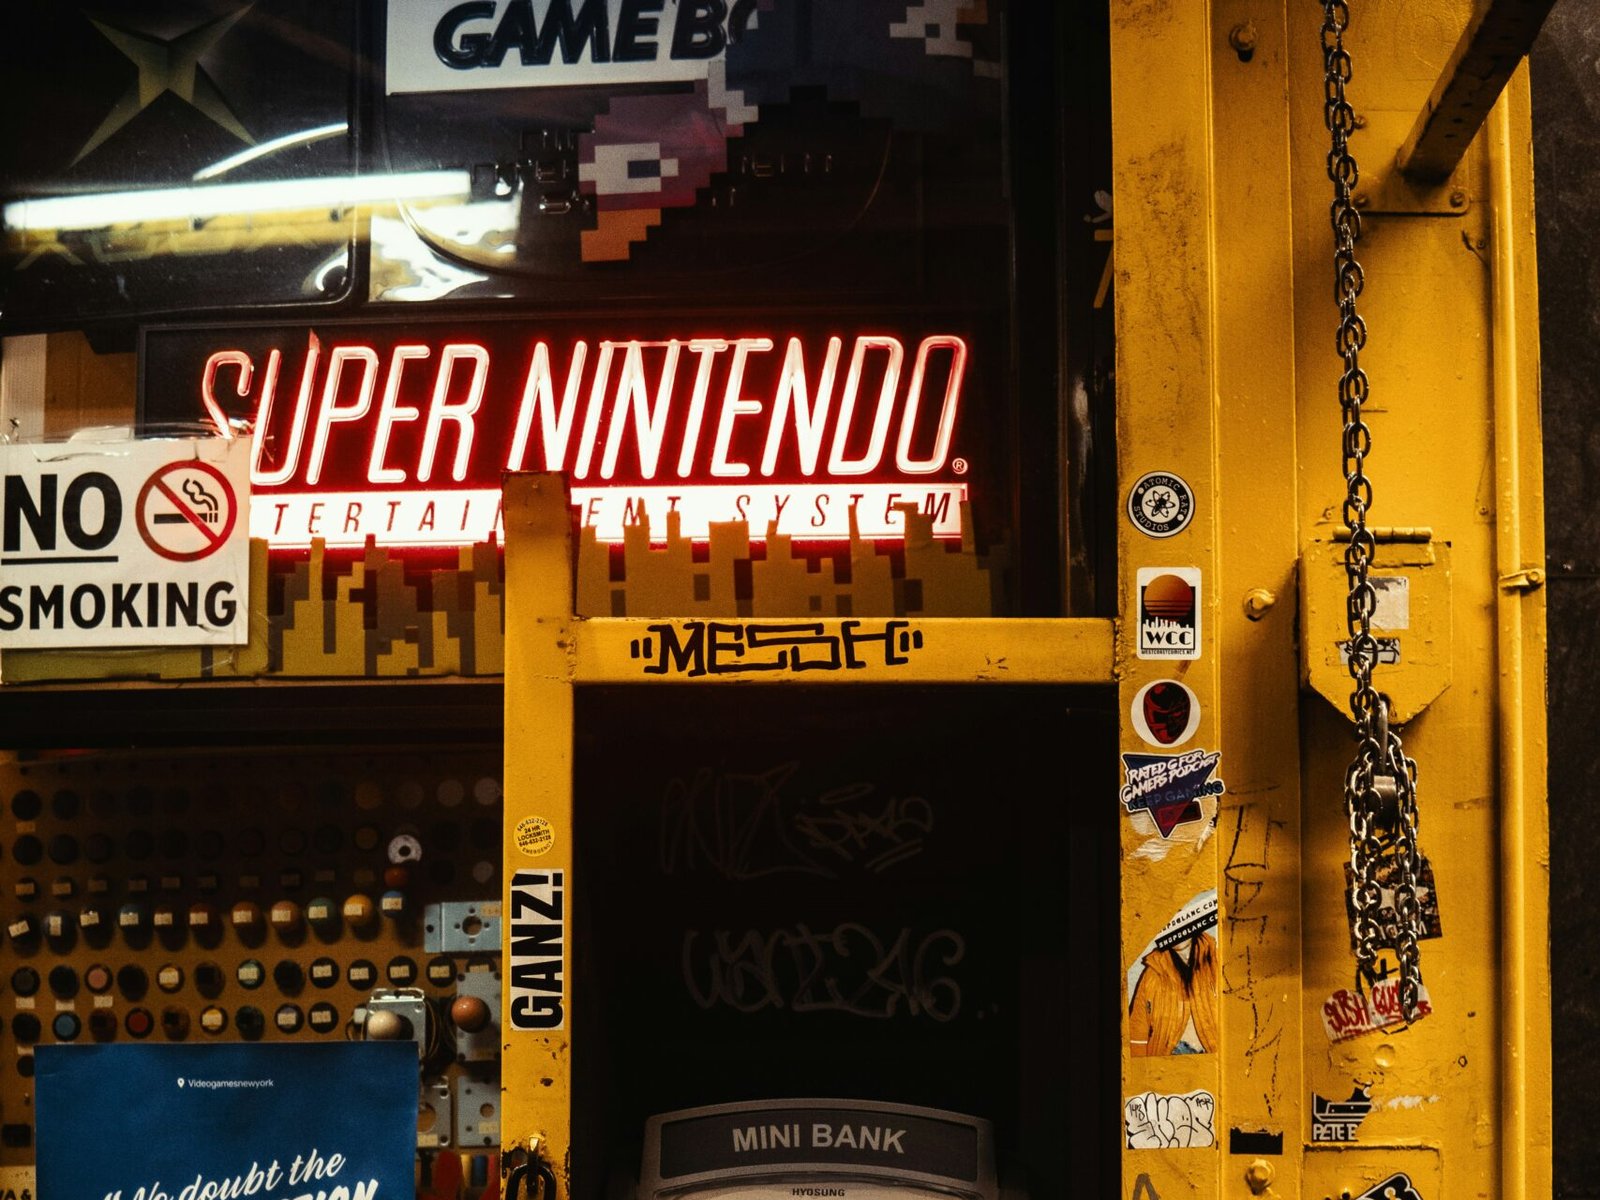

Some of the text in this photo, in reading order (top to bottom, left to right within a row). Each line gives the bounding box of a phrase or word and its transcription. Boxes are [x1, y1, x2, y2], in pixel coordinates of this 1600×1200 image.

[433, 0, 659, 70] GAME
[201, 335, 967, 486] SUPER NINTENDO
[1143, 477, 1189, 515] ATOMIC RAT
[3, 473, 122, 551] NO
[1134, 506, 1169, 531] STUDIOS
[0, 581, 237, 630] SMOKING
[1146, 631, 1192, 645] WCC
[1122, 754, 1219, 802] GAMERS PODCAST
[1128, 751, 1204, 784] RATED G FOR
[1128, 781, 1224, 810] KEEP GAMING
[517, 829, 550, 841] LOCKSMITH
[522, 841, 552, 854] EMERGENCY
[511, 872, 564, 1029] GANZ!
[188, 1078, 274, 1089] Videogamesnewyork
[733, 1124, 908, 1154] MINI BANK
[1312, 1124, 1345, 1140] PETE
[290, 1148, 346, 1183] the
[792, 1187, 845, 1197] HYOSUNG
